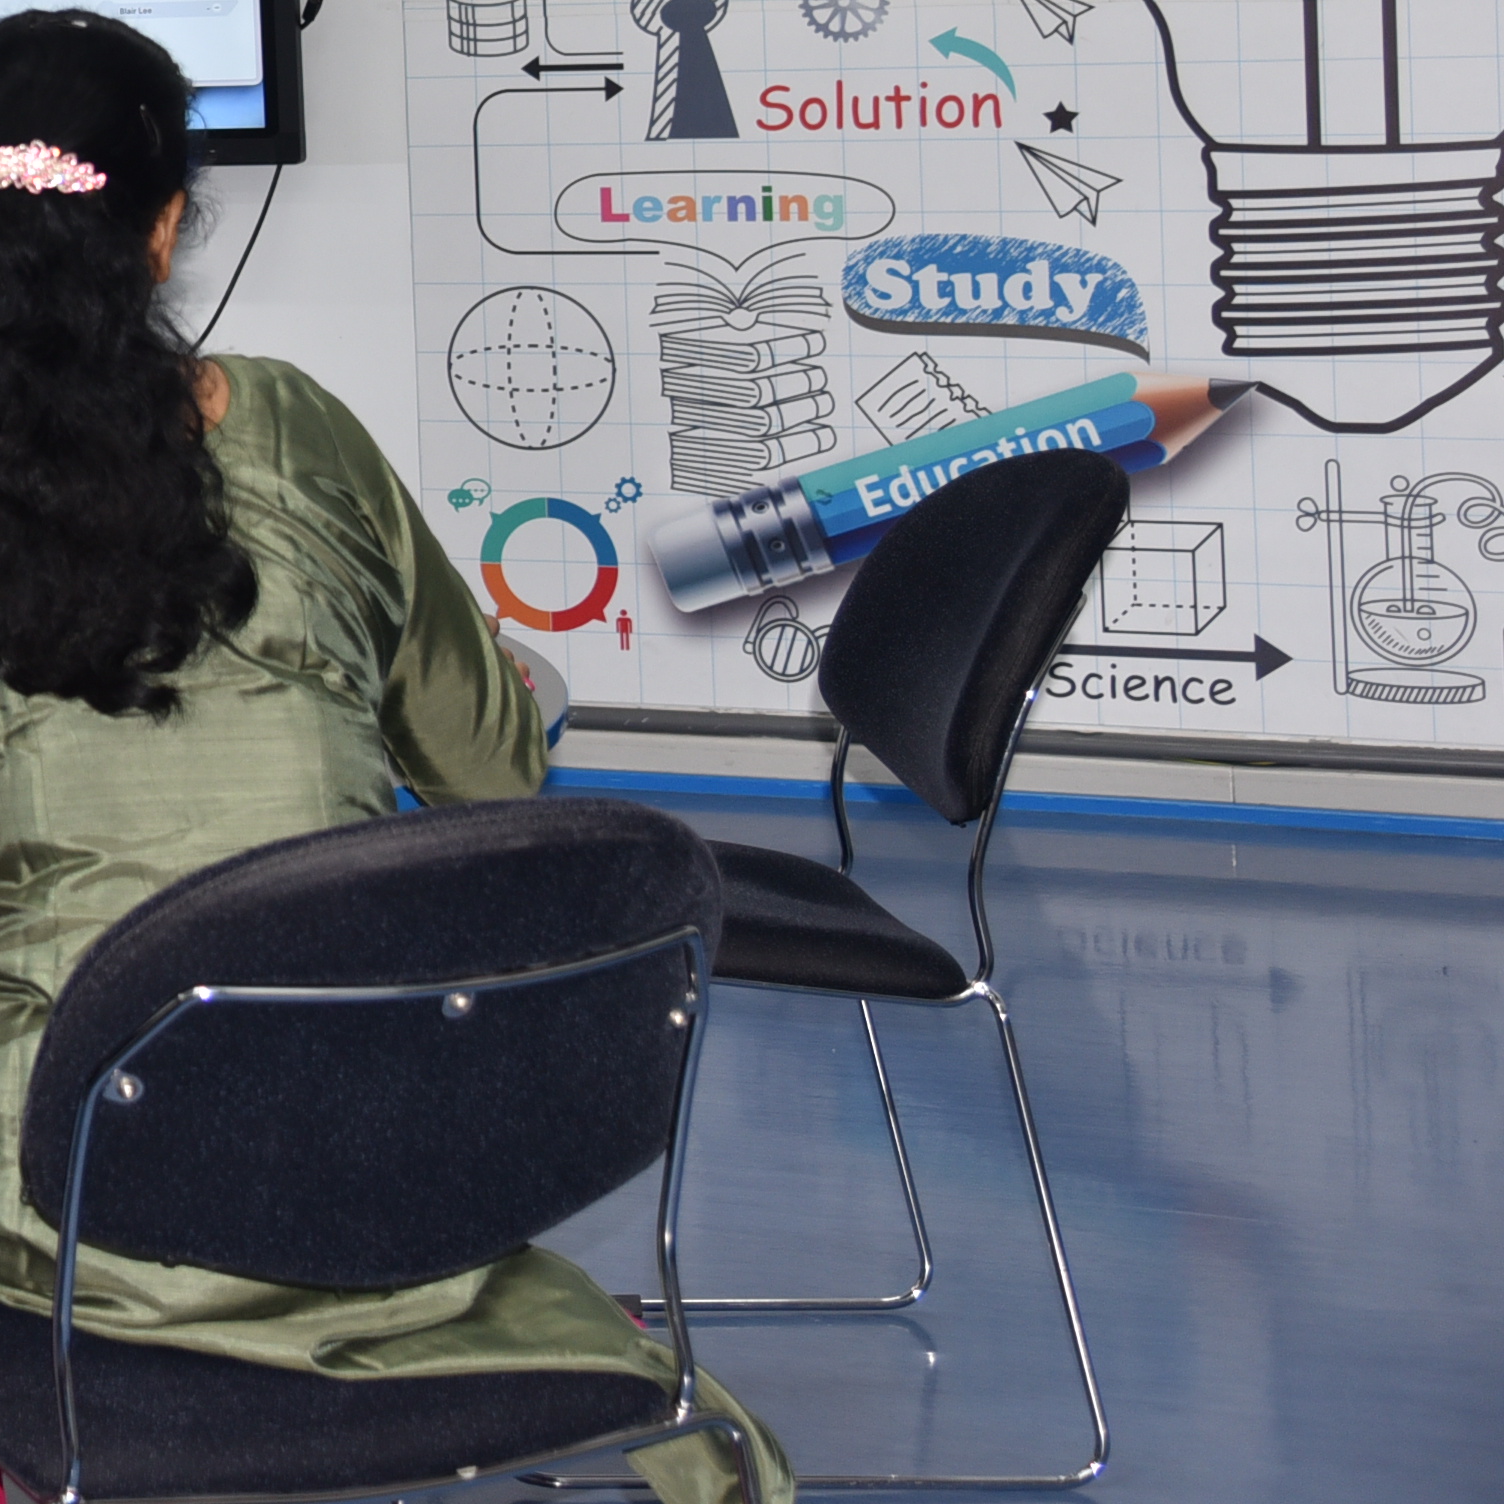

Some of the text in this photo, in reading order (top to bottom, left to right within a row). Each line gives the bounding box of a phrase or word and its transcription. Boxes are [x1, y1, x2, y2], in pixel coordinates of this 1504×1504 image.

[756, 79, 1003, 133] Solution
[599, 185, 845, 232] Learning
[865, 259, 1104, 323] Study
[854, 417, 1103, 517] Eduction
[1045, 661, 1237, 706] Science
